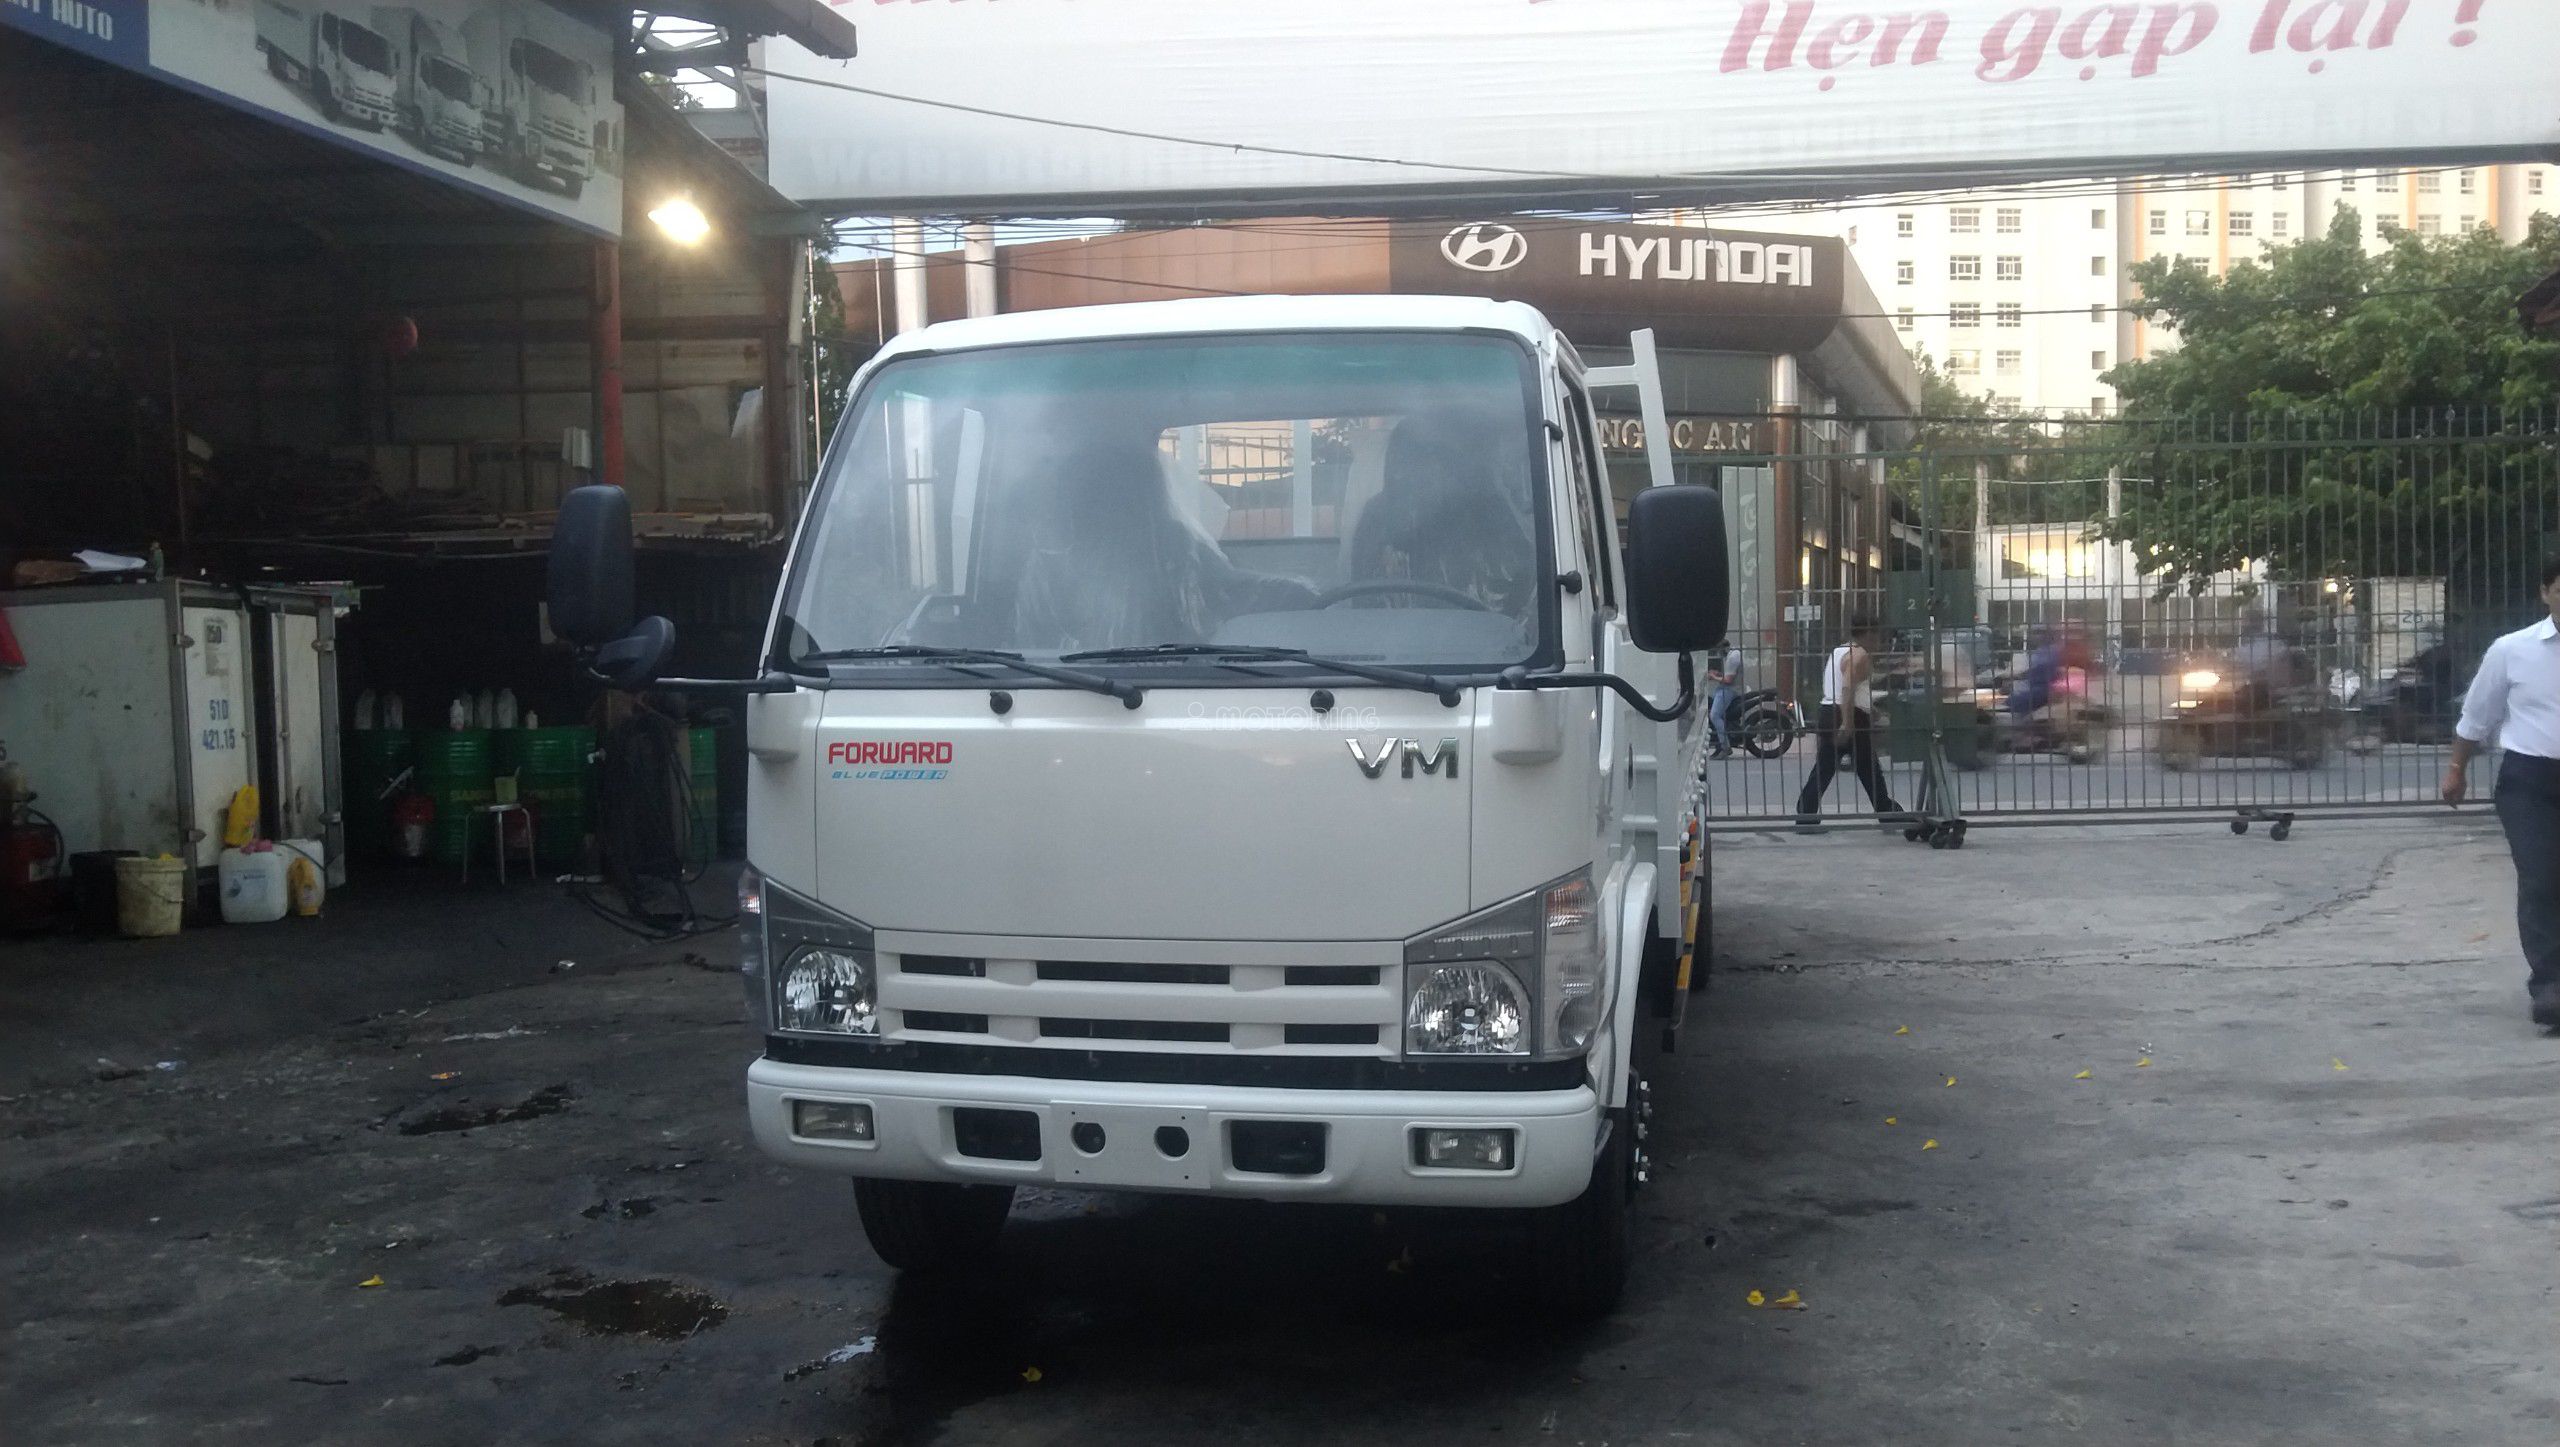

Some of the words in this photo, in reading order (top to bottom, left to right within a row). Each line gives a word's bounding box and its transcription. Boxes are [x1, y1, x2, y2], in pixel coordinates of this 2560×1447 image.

[52, 0, 112, 41] AUTO
[1719, 0, 1951, 92] Hẹn
[1580, 232, 1812, 286] HYUNDAI
[1597, 419, 1693, 449] NGC
[1703, 422, 1752, 450] AN
[828, 741, 953, 765] FORWARD
[1345, 737, 1460, 780] VM
